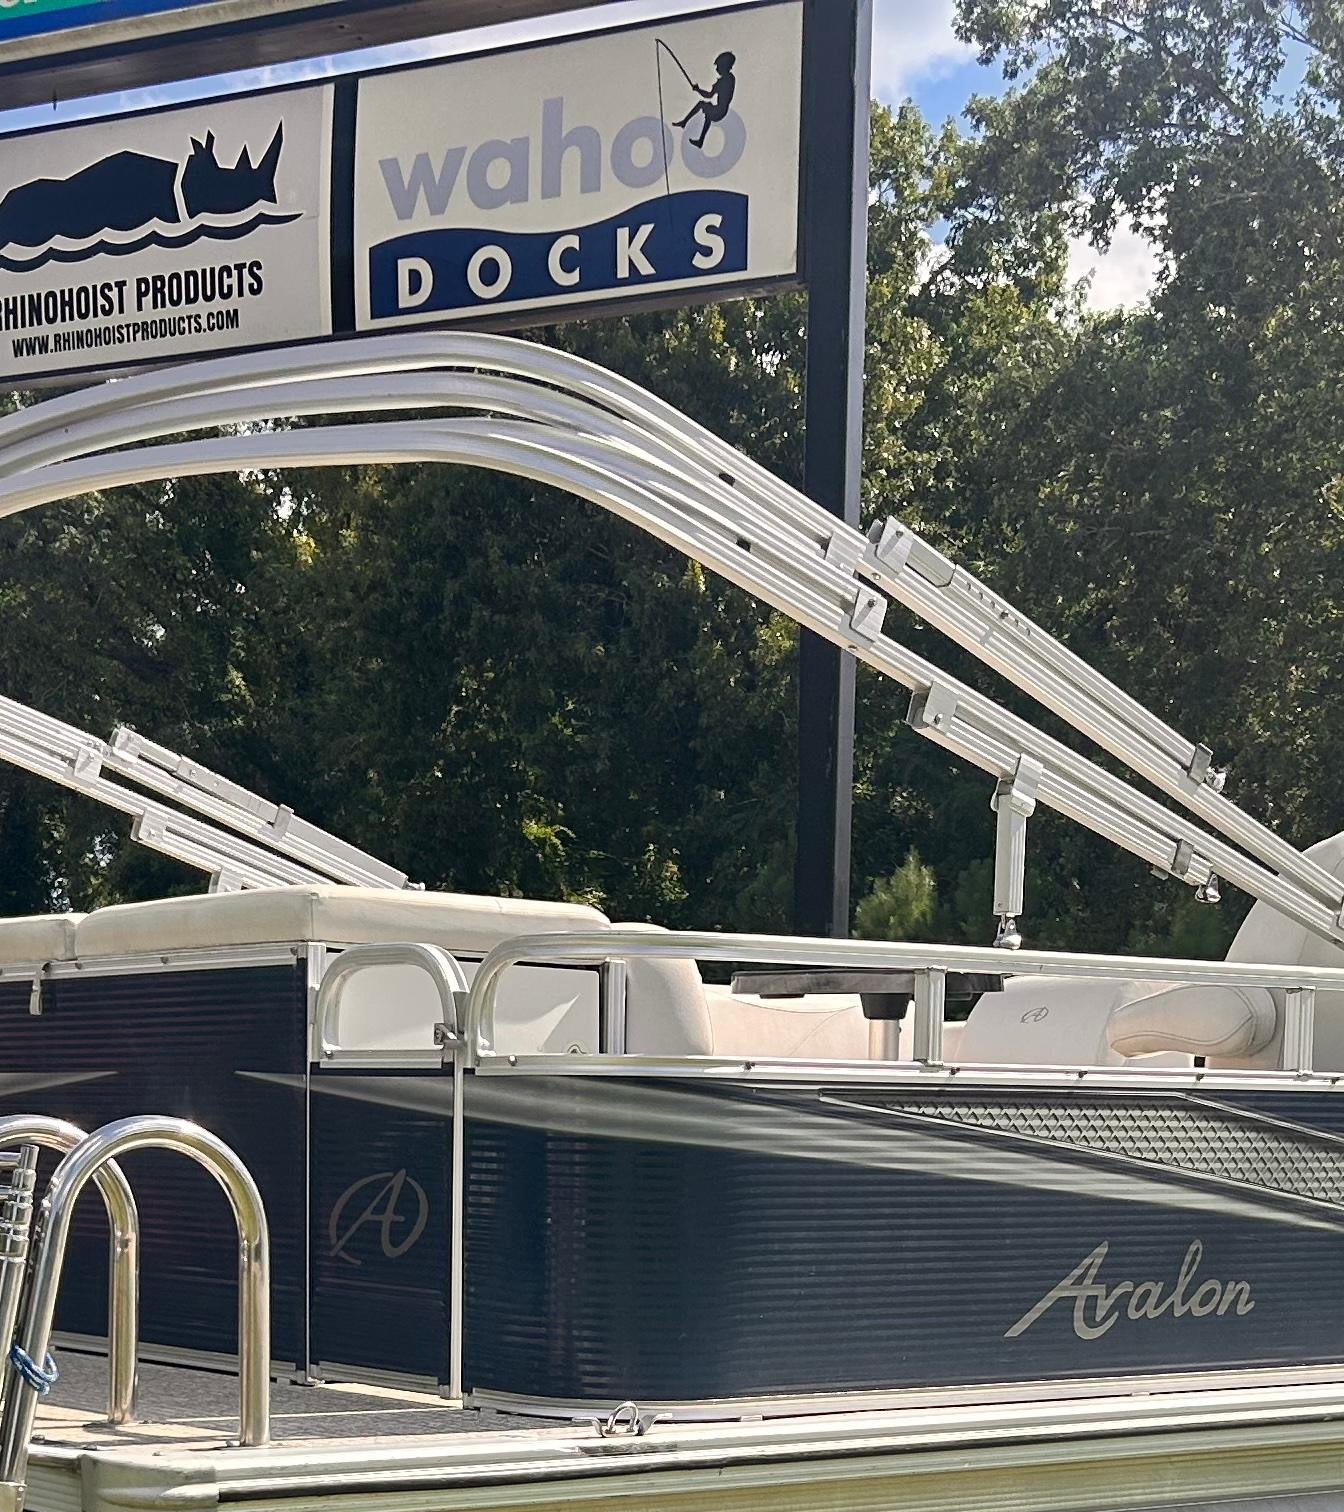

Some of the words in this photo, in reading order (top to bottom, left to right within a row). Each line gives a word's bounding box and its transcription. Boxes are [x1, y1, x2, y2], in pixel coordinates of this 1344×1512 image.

[378, 96, 747, 221] wahoo
[136, 260, 263, 312] PRODUCTS
[397, 213, 725, 309] DOCKS
[12, 308, 240, 358] WWW.RHINOHOISTPRODUCTS.COM
[1003, 1239, 1256, 1340] Avalon
